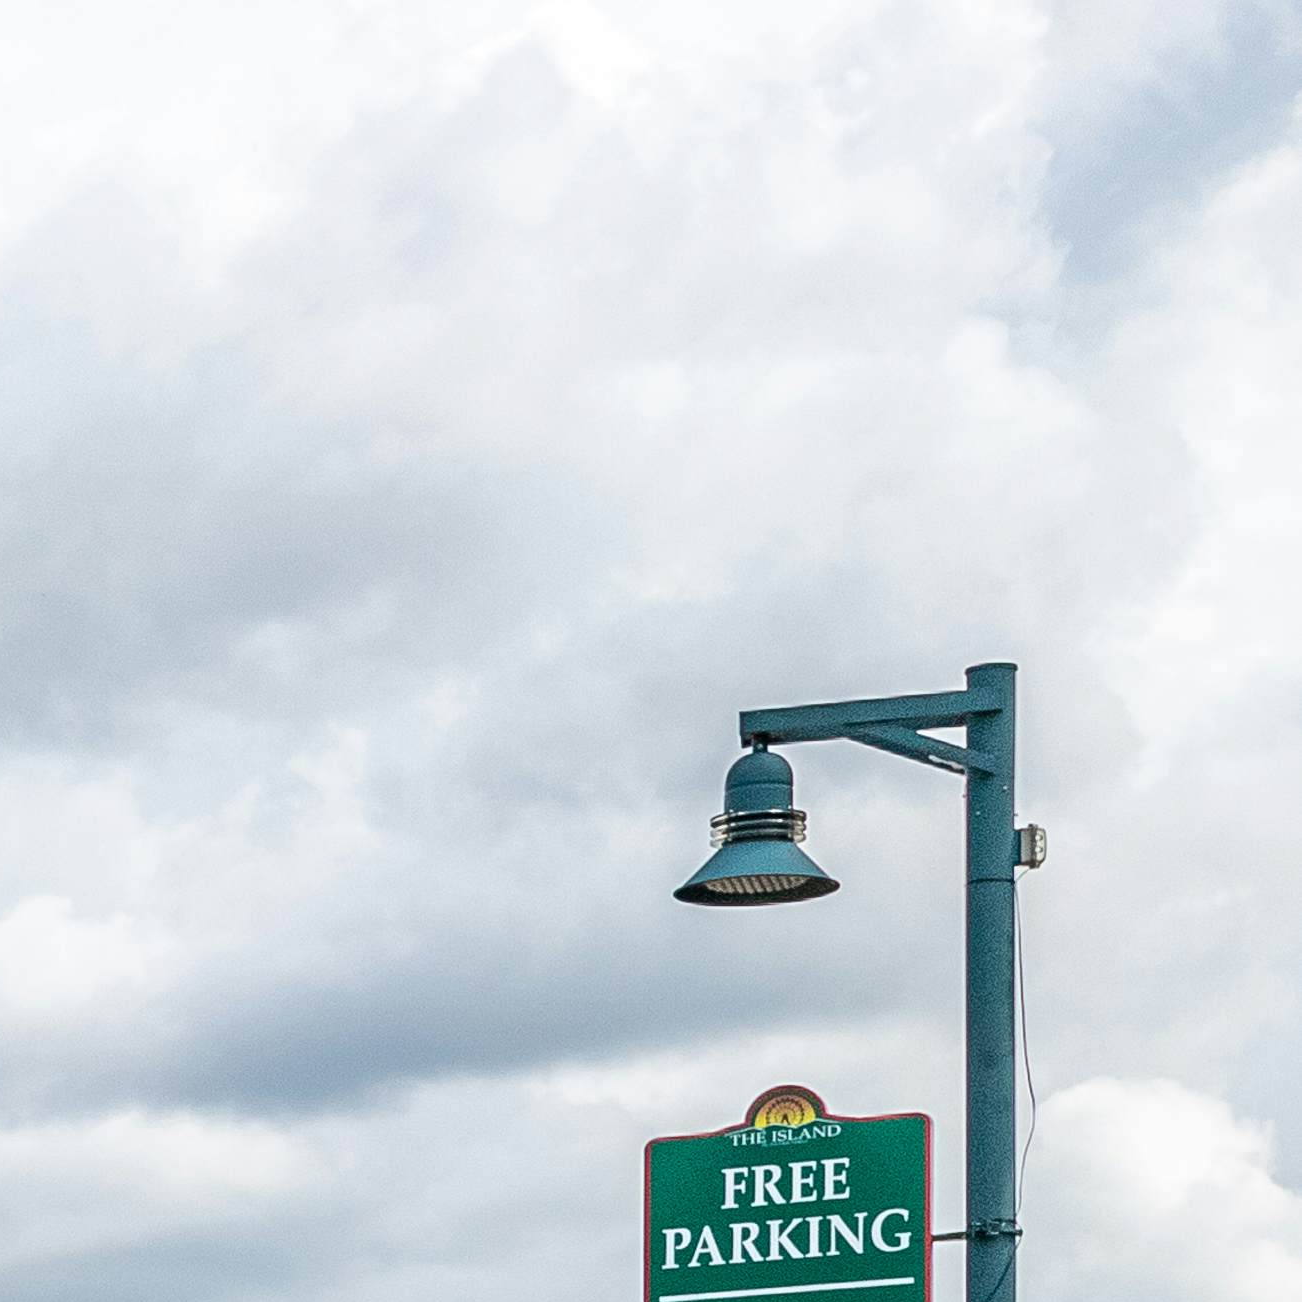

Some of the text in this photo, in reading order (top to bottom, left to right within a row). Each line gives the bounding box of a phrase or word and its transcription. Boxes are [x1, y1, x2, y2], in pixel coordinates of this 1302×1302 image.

[730, 1131, 766, 1147] THE
[772, 1124, 842, 1143] ISLAND
[721, 1157, 851, 1210] FREE
[661, 1208, 912, 1270] PARKING
